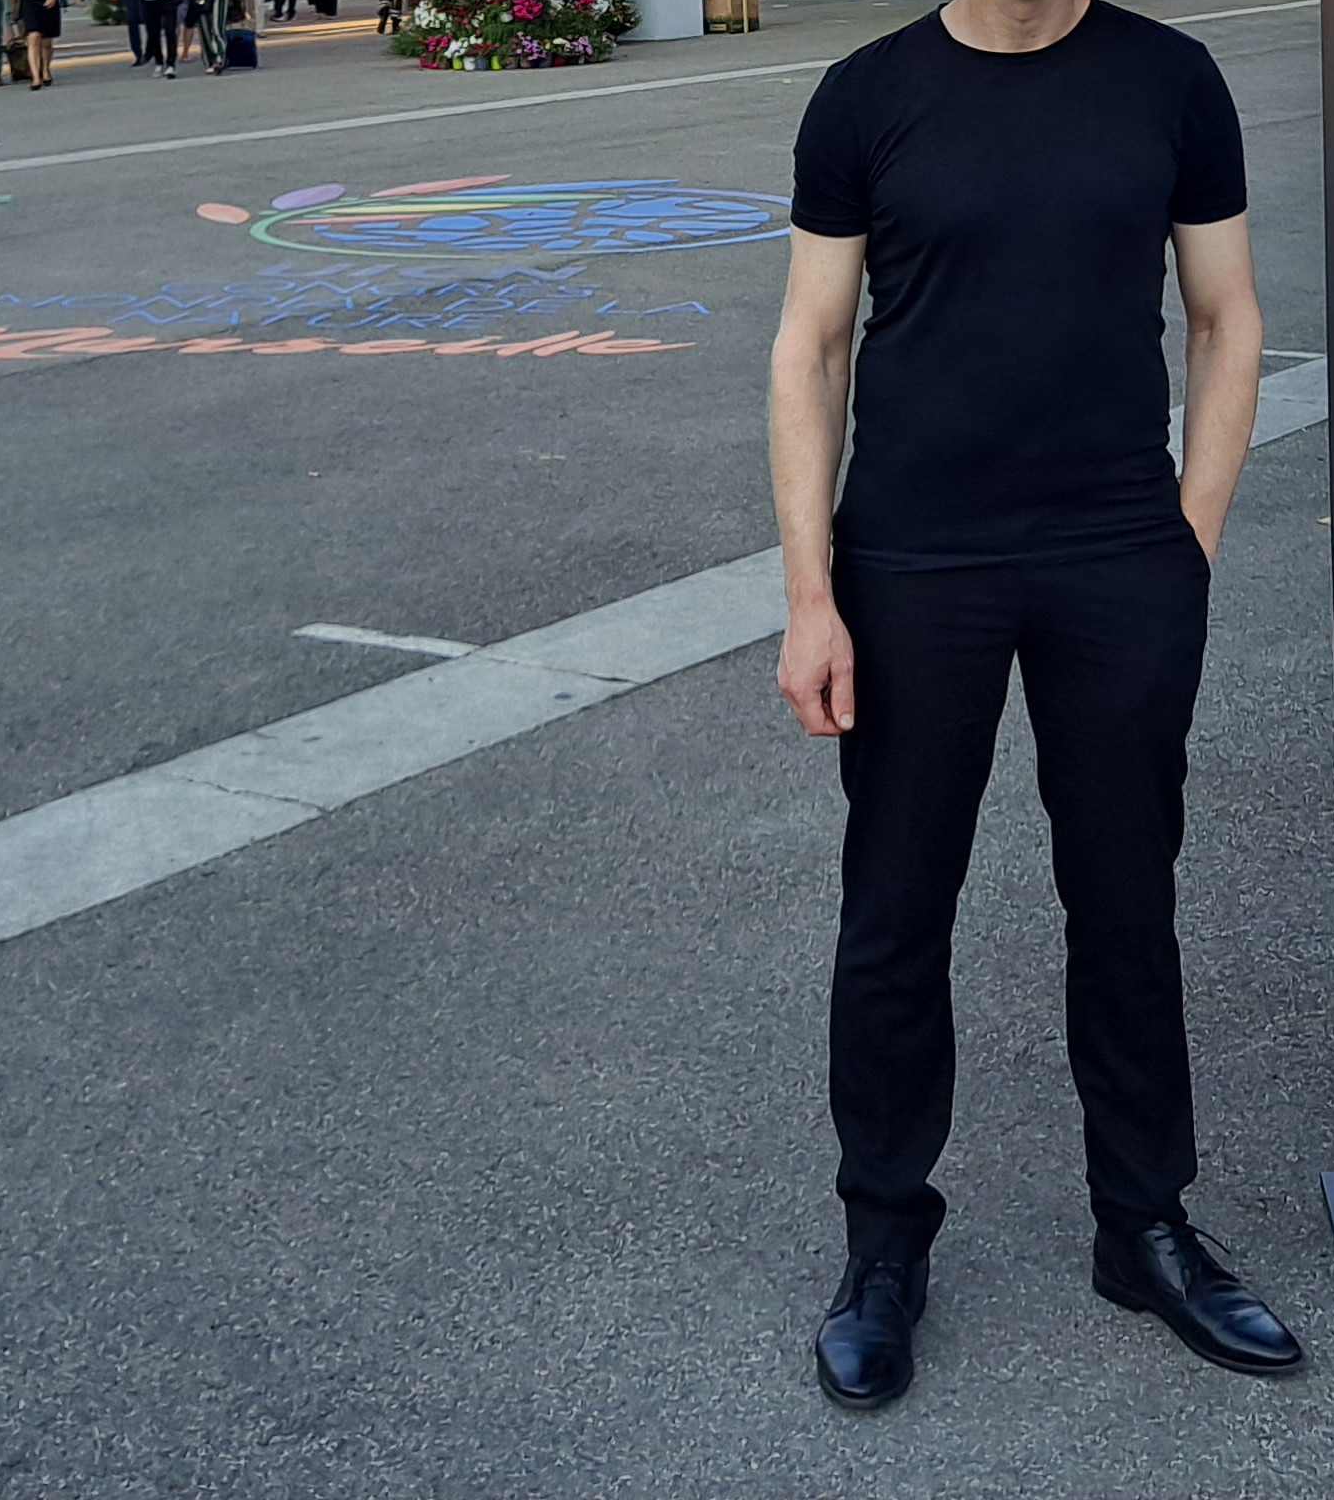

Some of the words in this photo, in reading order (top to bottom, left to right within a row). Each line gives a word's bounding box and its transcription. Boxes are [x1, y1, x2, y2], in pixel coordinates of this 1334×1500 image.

[255, 262, 587, 282] UICN
[442, 298, 580, 315] DE
[596, 299, 714, 316] LA
[108, 309, 505, 330] NATURE
